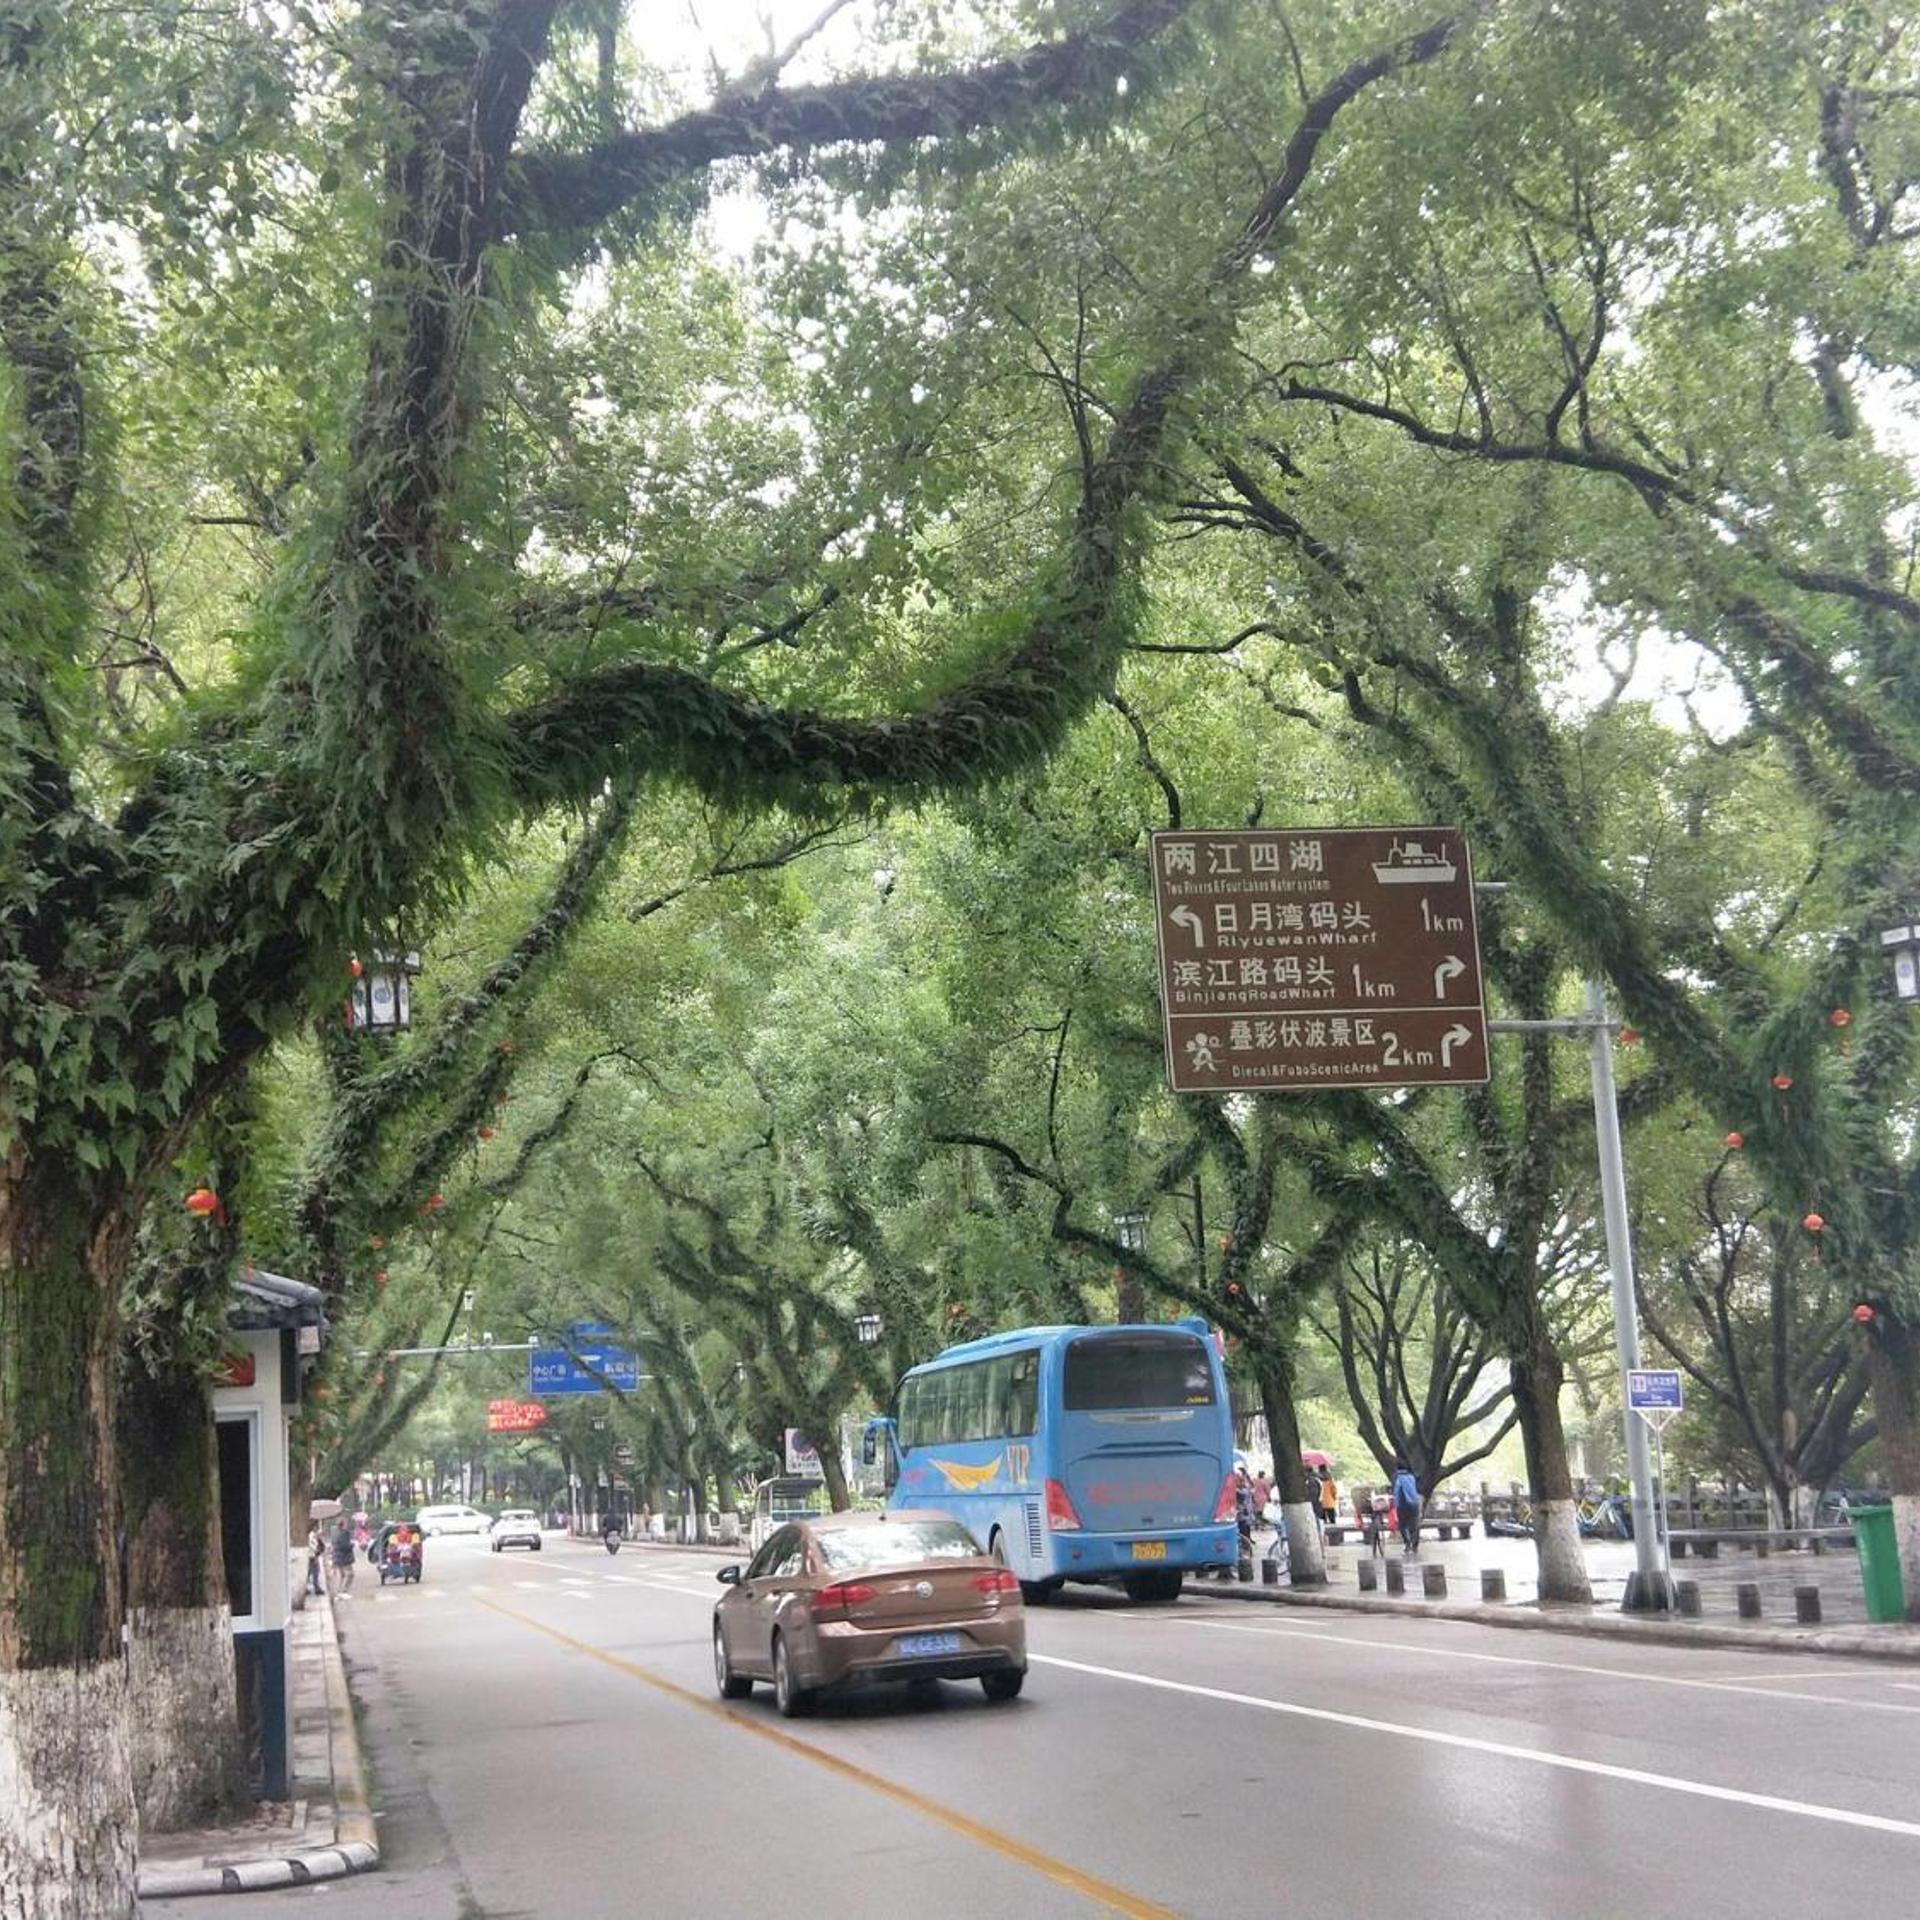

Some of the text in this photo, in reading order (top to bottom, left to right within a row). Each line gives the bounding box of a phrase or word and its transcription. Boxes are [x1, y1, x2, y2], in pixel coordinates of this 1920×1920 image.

[1162, 840, 1324, 876] 两江四湖
[1215, 901, 1371, 933] 日月湾码头
[1172, 955, 1335, 987] 滨江路码头
[1229, 1018, 1377, 1050] 叠彩伏波景区
